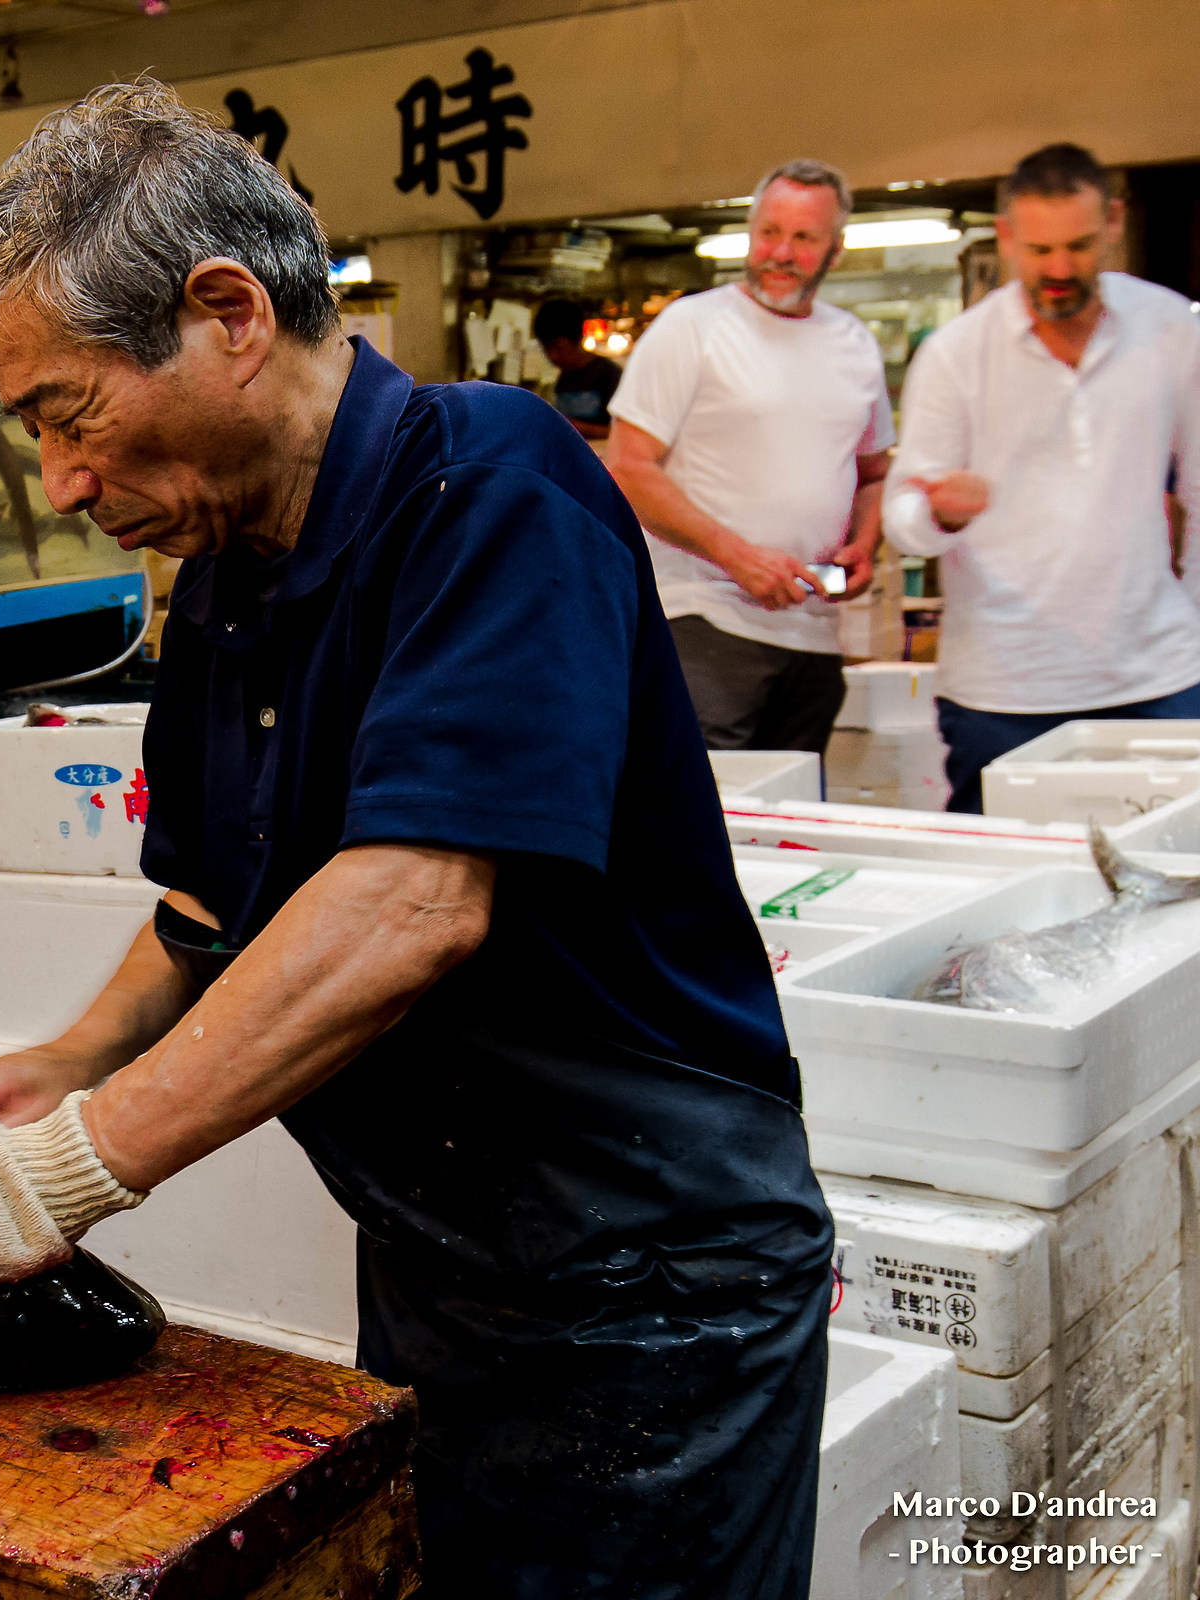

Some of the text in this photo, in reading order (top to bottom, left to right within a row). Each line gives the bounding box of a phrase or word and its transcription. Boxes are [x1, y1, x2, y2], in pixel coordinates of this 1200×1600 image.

[891, 1288, 941, 1318] 北海道
[897, 1315, 941, 1336] 原産地
